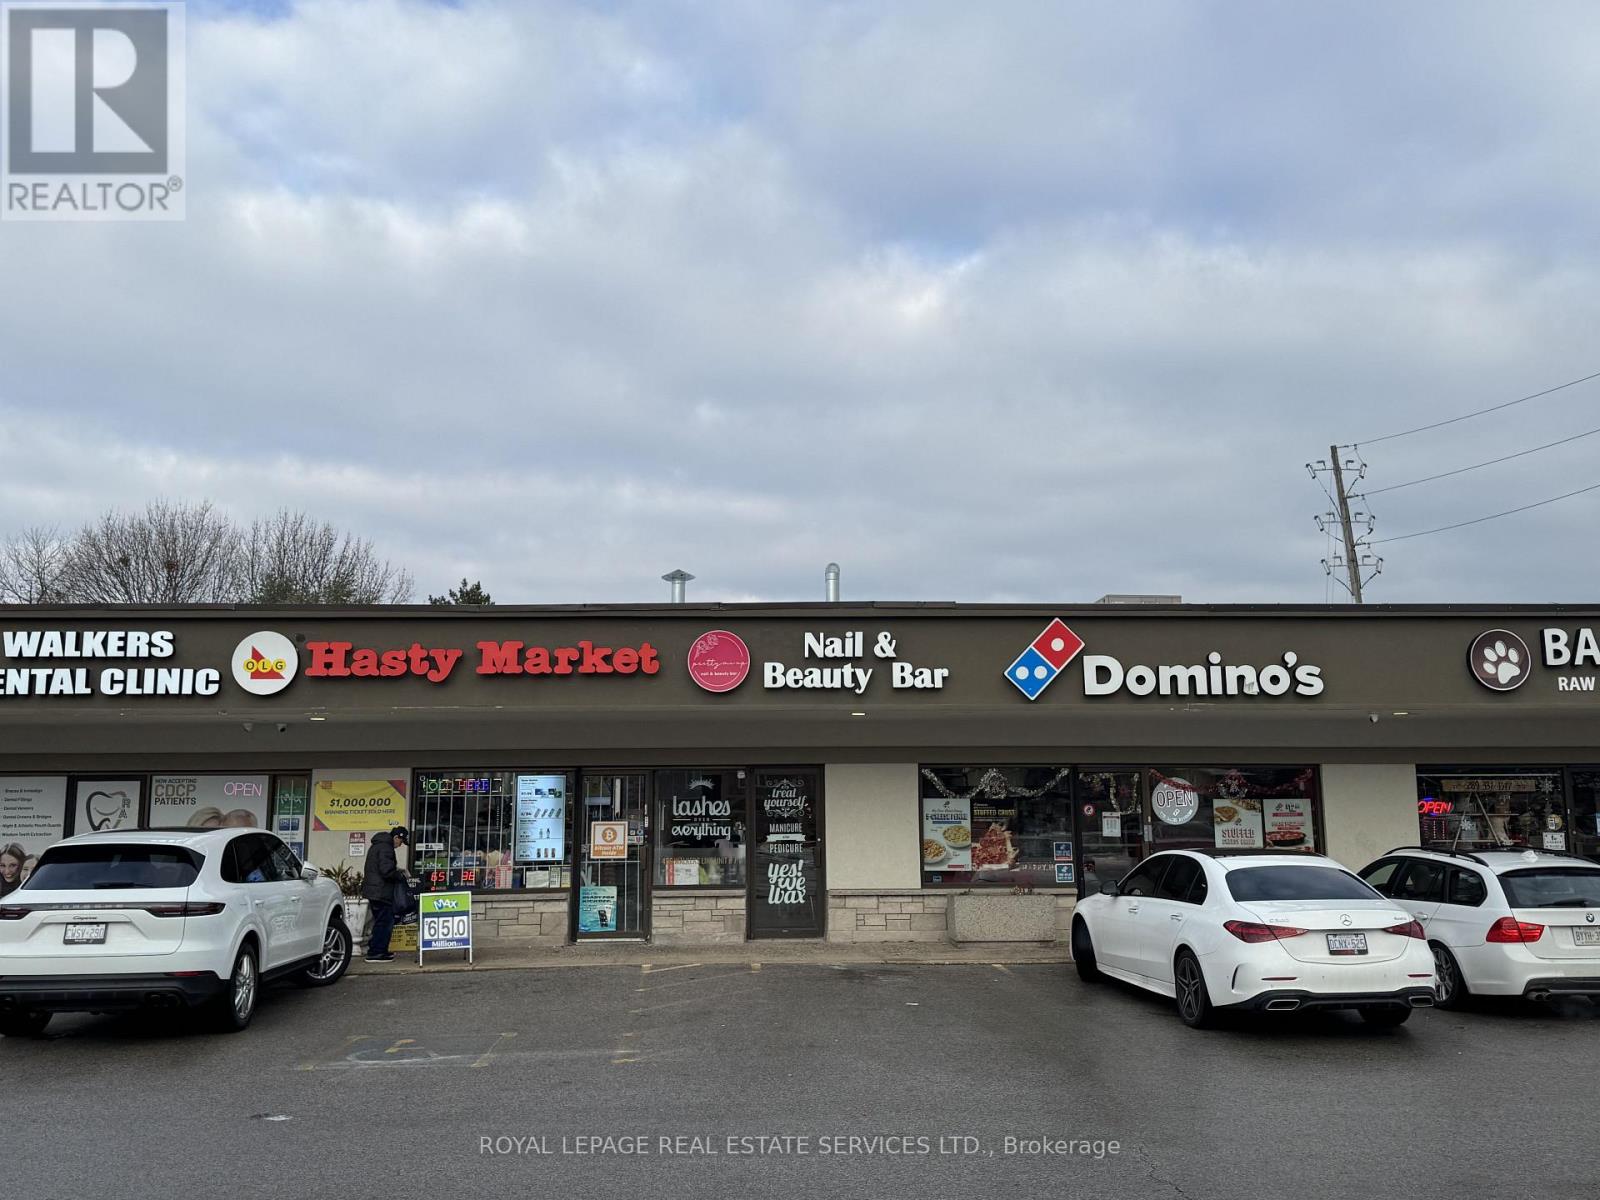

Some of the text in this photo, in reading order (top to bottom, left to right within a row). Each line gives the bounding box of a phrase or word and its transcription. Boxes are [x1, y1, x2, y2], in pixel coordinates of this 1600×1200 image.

[3, 630, 175, 659] WALKERS
[804, 631, 897, 659] Nail &
[243, 658, 287, 673] OLG
[304, 641, 659, 683] Hasty Market
[763, 662, 949, 694] Beauty Bar
[1082, 651, 1325, 696] Domino's
[100, 667, 220, 697] CLINIC
[1557, 676, 1596, 691] RAW
[155, 784, 197, 797] CDCP
[223, 782, 262, 797] OPEN
[771, 787, 796, 798] treat
[154, 797, 197, 806] PATIENTS
[329, 797, 391, 808] $1,000,000
[672, 795, 731, 816] lashes
[1155, 788, 1194, 809] OPEN
[1417, 800, 1452, 814] OPEN
[671, 822, 731, 841] everything
[769, 822, 803, 833] MANICURE
[769, 843, 803, 854] PEDICURE
[767, 859, 804, 884] yes!
[778, 875, 806, 891] we
[767, 884, 806, 905] wax
[431, 940, 457, 948] Million
